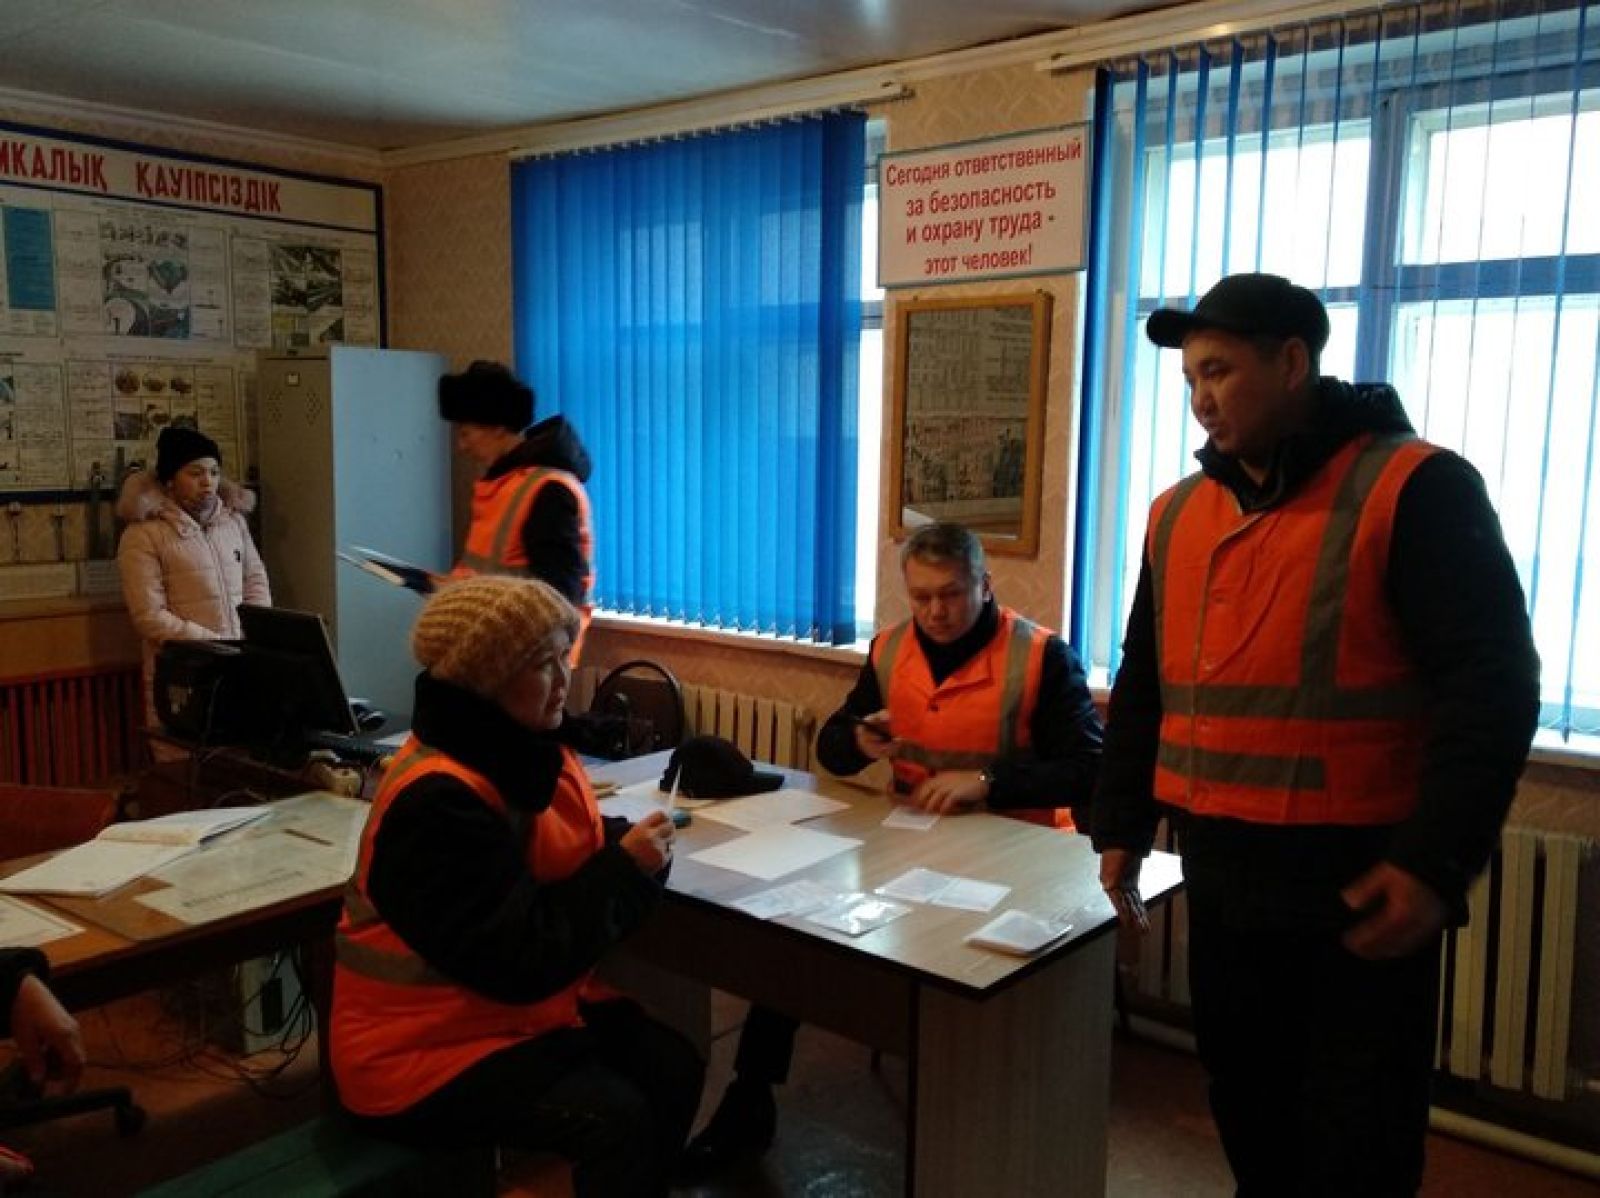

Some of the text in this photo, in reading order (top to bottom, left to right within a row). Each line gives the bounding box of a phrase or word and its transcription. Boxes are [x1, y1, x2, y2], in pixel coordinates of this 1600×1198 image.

[886, 138, 1081, 187] Сегодня ответственный
[137, 161, 281, 213] ҚАУІПСІЗДІК
[906, 181, 1056, 218] за безопасность
[906, 228, 917, 245] и
[921, 219, 984, 246] охрану
[990, 211, 1042, 240] труда
[924, 244, 1032, 275] этот человек!
